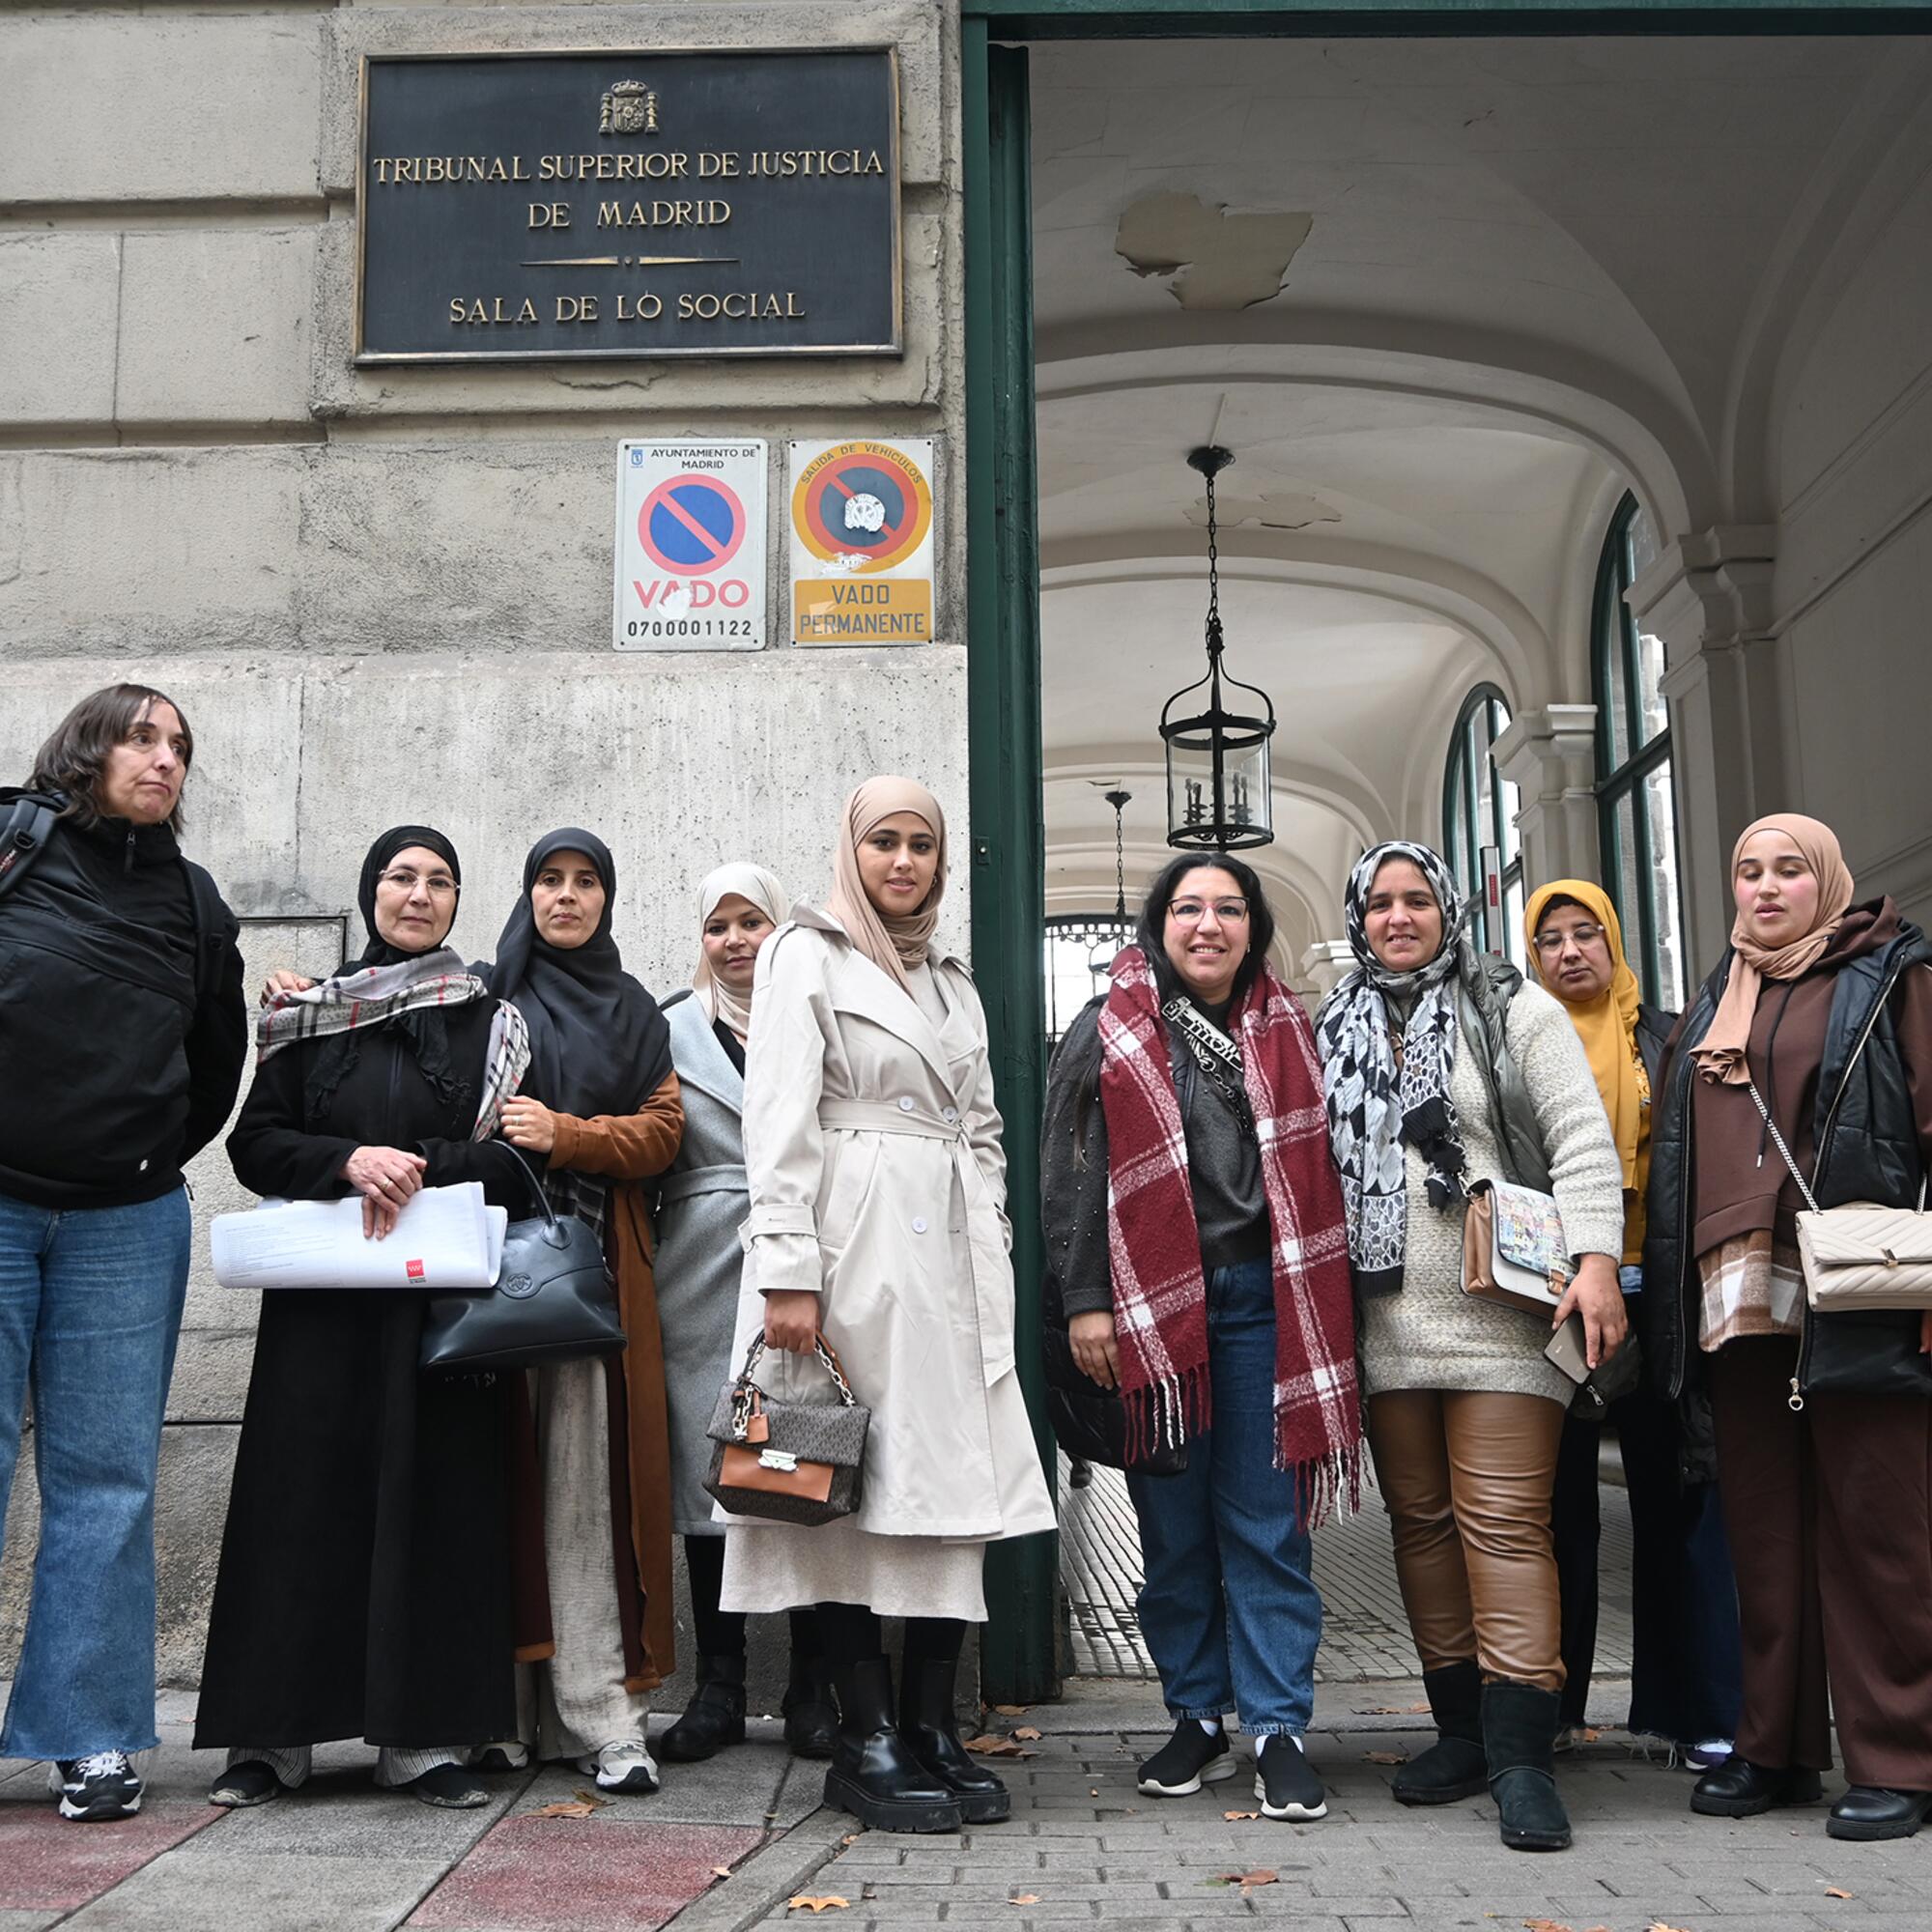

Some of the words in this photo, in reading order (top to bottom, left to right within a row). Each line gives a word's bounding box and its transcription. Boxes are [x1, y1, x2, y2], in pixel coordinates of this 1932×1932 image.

[374, 156, 530, 183] TRIBUNAL
[540, 153, 689, 181] SUPERIOR
[698, 152, 740, 178] DE
[748, 150, 885, 177] JUSTICIA
[528, 203, 570, 228] DE
[596, 200, 731, 228] MADRID
[450, 297, 538, 324] SALA
[555, 296, 598, 322] DE
[616, 294, 663, 320] LO
[678, 292, 806, 320] SOCIAL
[650, 448, 739, 458] AYUNTAMIENTO
[742, 448, 756, 458] DE
[681, 460, 724, 469] MADRID
[801, 452, 835, 484] SALIDA
[839, 444, 857, 456] DE
[865, 443, 923, 484] VEHICULOS
[832, 583, 891, 605] VADO
[628, 620, 752, 637] 0700001122
[800, 612, 925, 635] PERMANENTE
